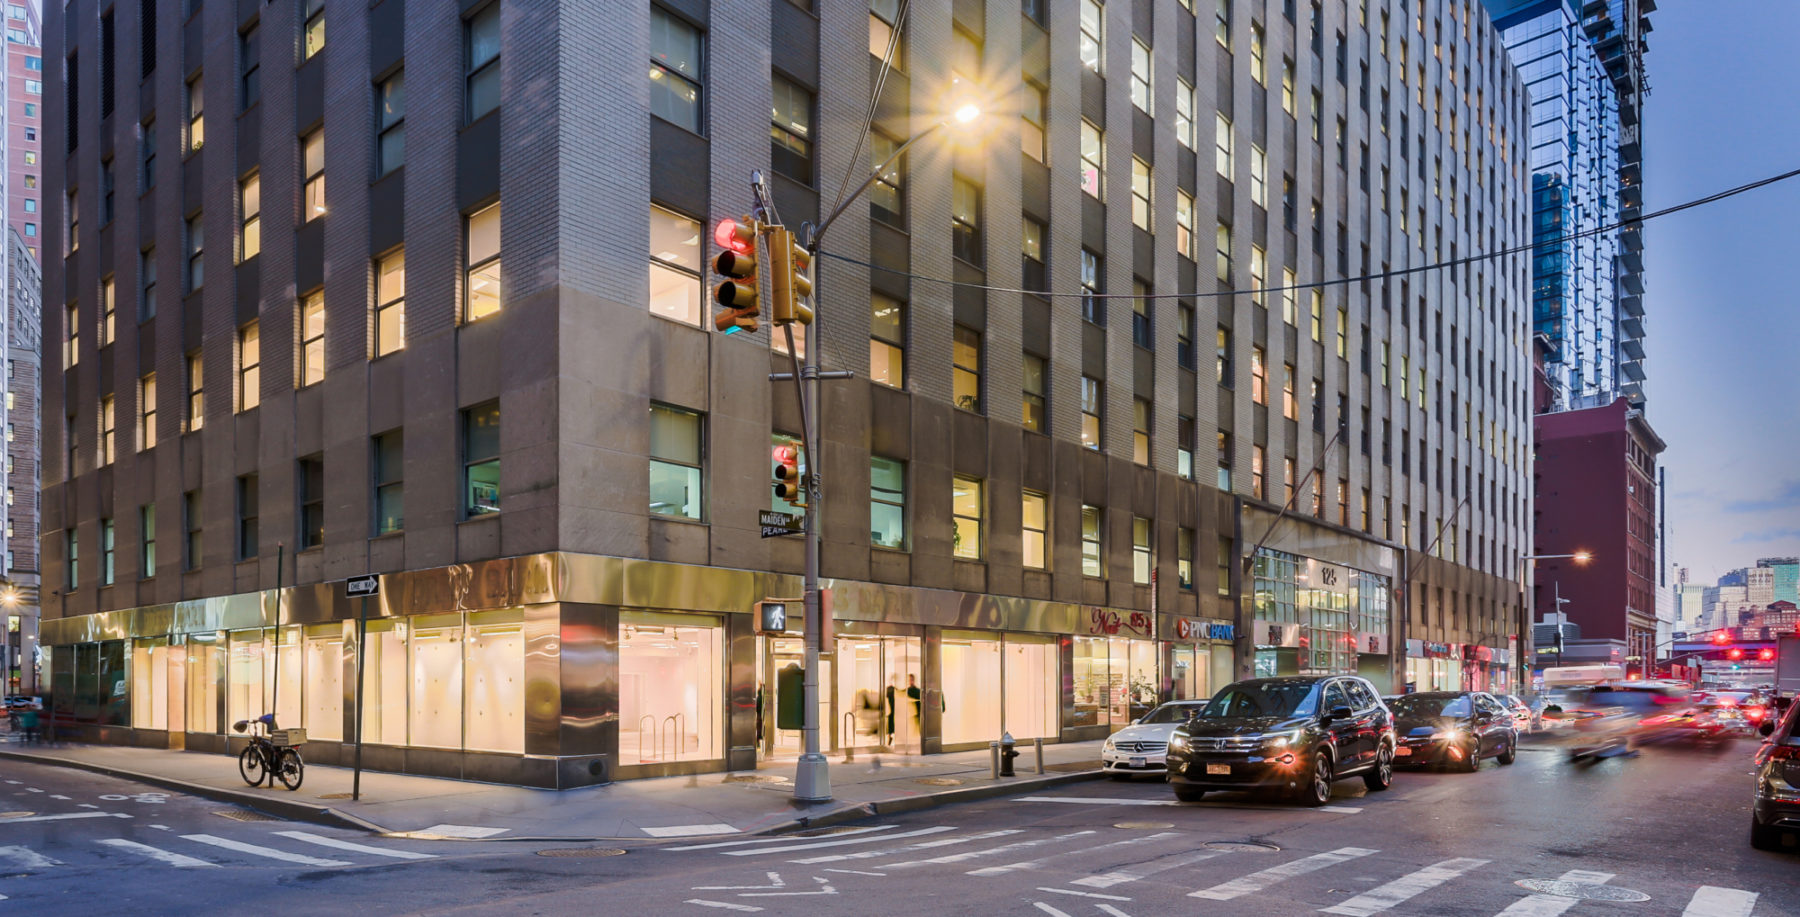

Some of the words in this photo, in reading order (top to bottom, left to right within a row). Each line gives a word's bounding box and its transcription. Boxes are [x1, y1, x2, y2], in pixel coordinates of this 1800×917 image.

[761, 514, 785, 526] MAIDEN
[364, 581, 375, 589] WAY
[1190, 621, 1211, 639] PNC
[1211, 623, 1234, 641] BANK
